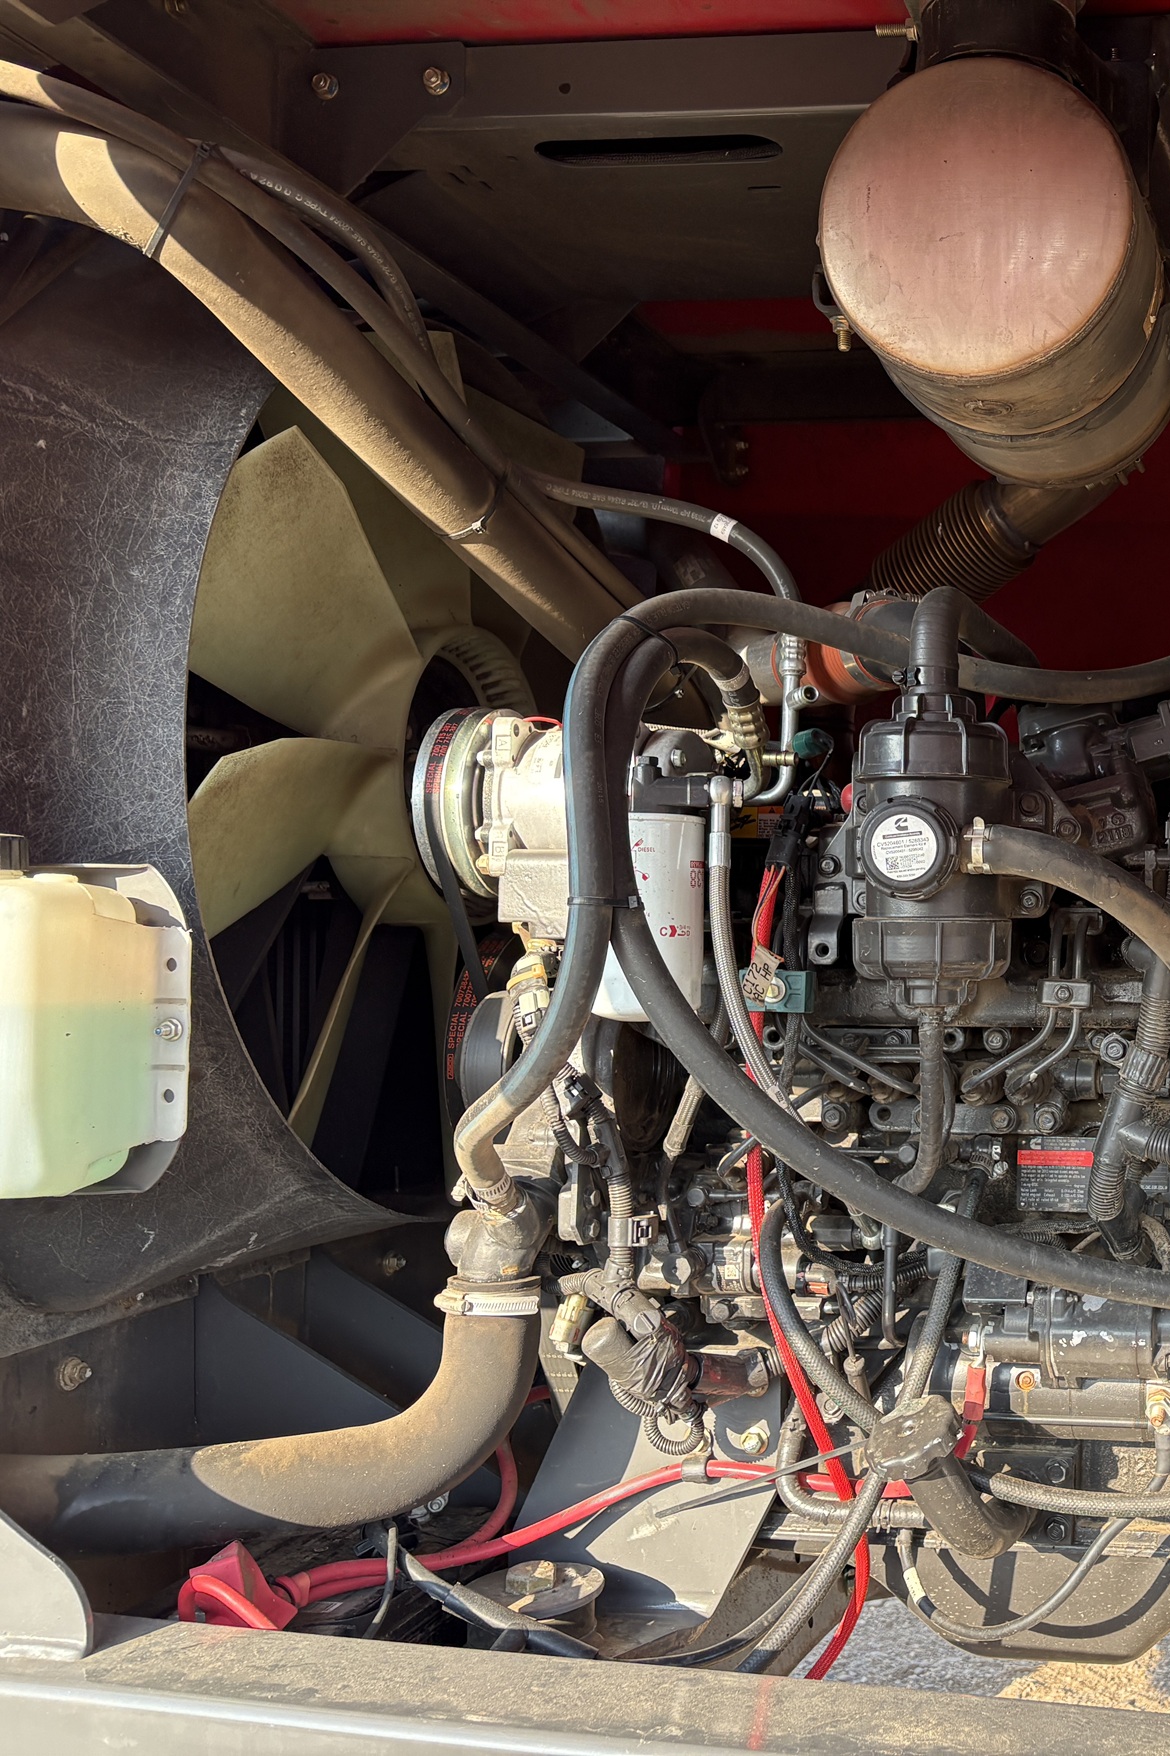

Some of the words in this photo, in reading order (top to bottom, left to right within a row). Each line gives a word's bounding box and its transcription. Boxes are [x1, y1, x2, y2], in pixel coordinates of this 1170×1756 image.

[425, 761, 437, 794] SPECIAL
[659, 926, 668, 937] C
[742, 962, 762, 995] C172
[752, 984, 765, 1003] AC
[760, 962, 773, 981] HP
[447, 1011, 459, 1049] SPECIAL
